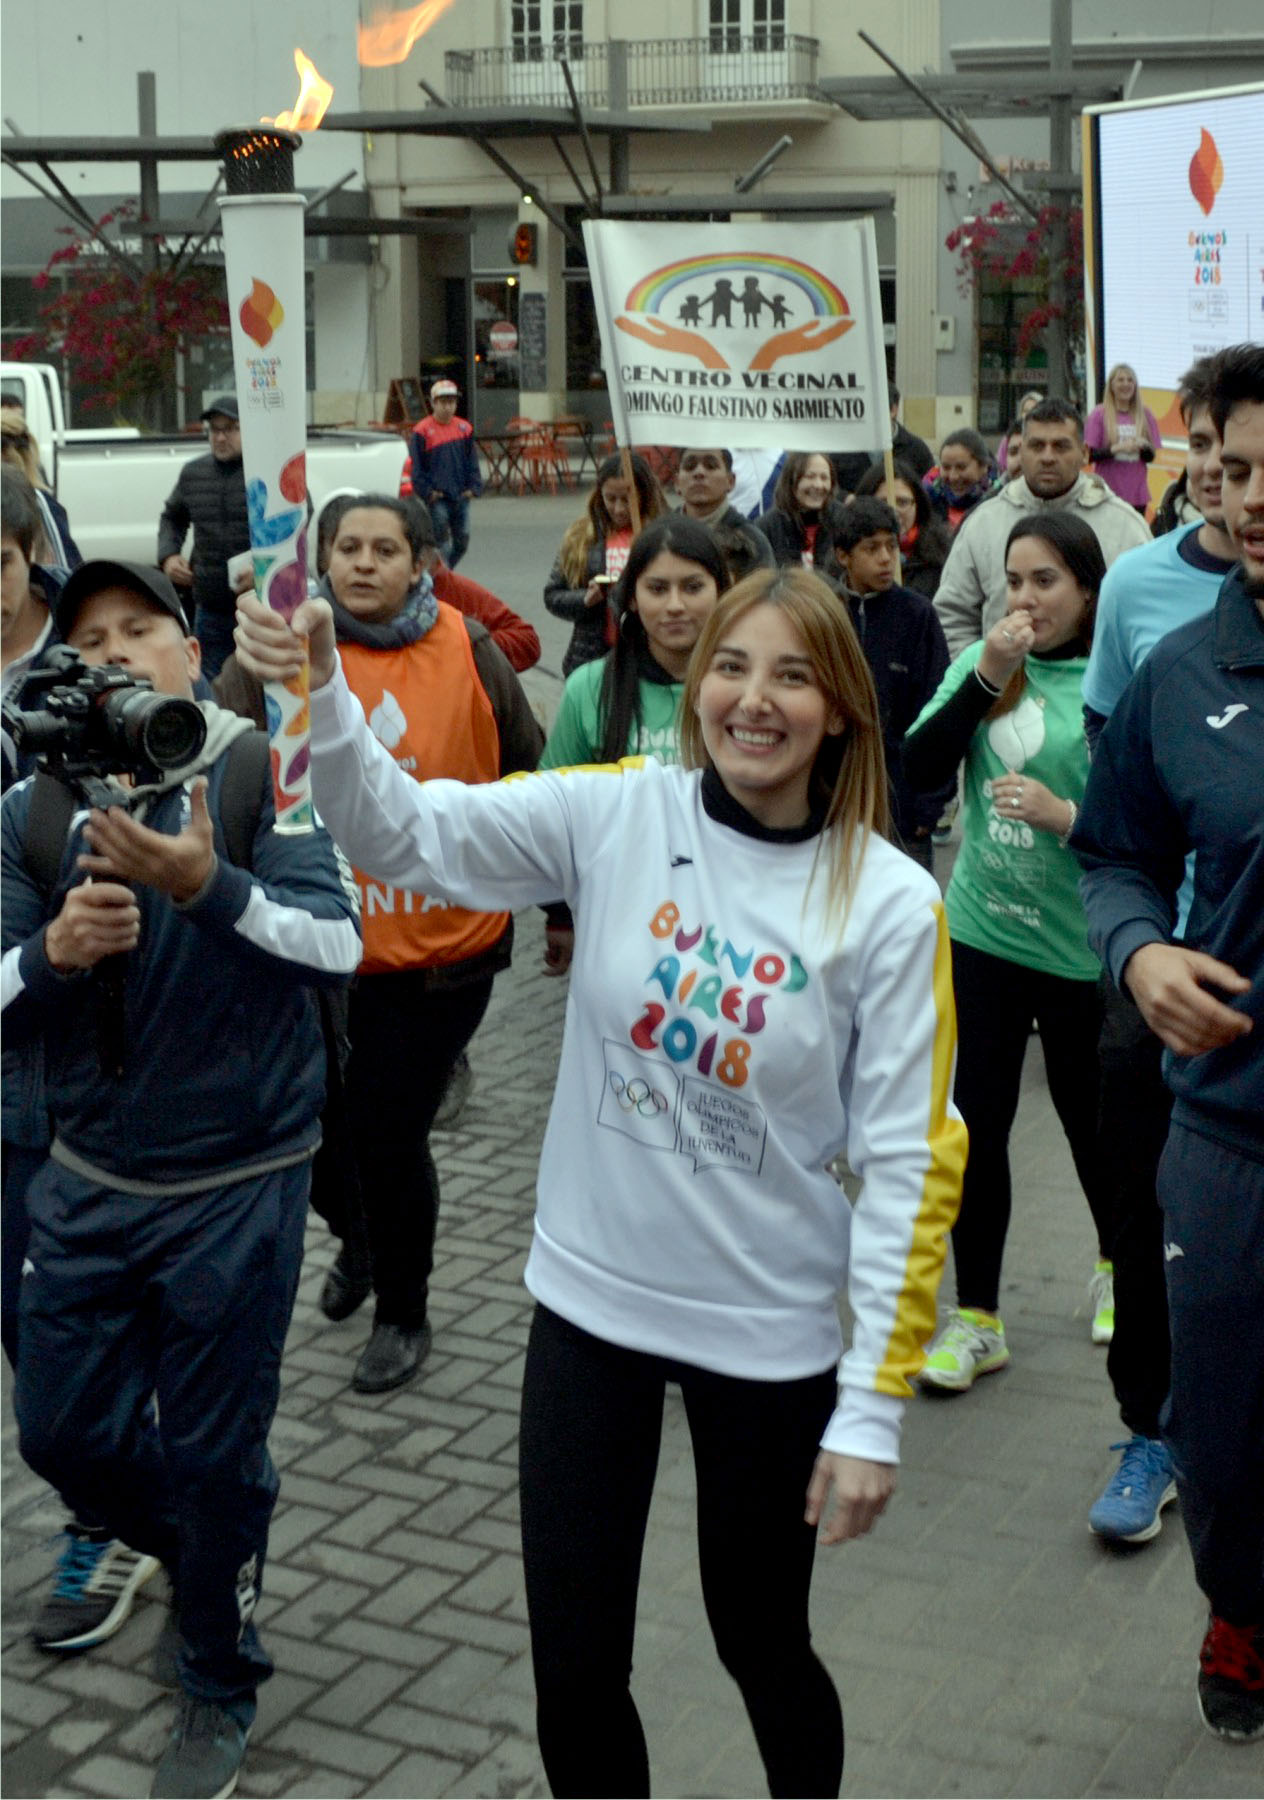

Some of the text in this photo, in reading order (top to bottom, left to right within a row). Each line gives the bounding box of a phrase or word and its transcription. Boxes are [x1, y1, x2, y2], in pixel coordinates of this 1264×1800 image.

[621, 365, 865, 389] CENTRO VECINAL
[625, 391, 865, 420] OMINGO FAUSTINO SARMIENTO
[649, 900, 809, 992] BUENOS
[645, 956, 771, 1034] AIRES
[630, 1002, 752, 1088] 2018
